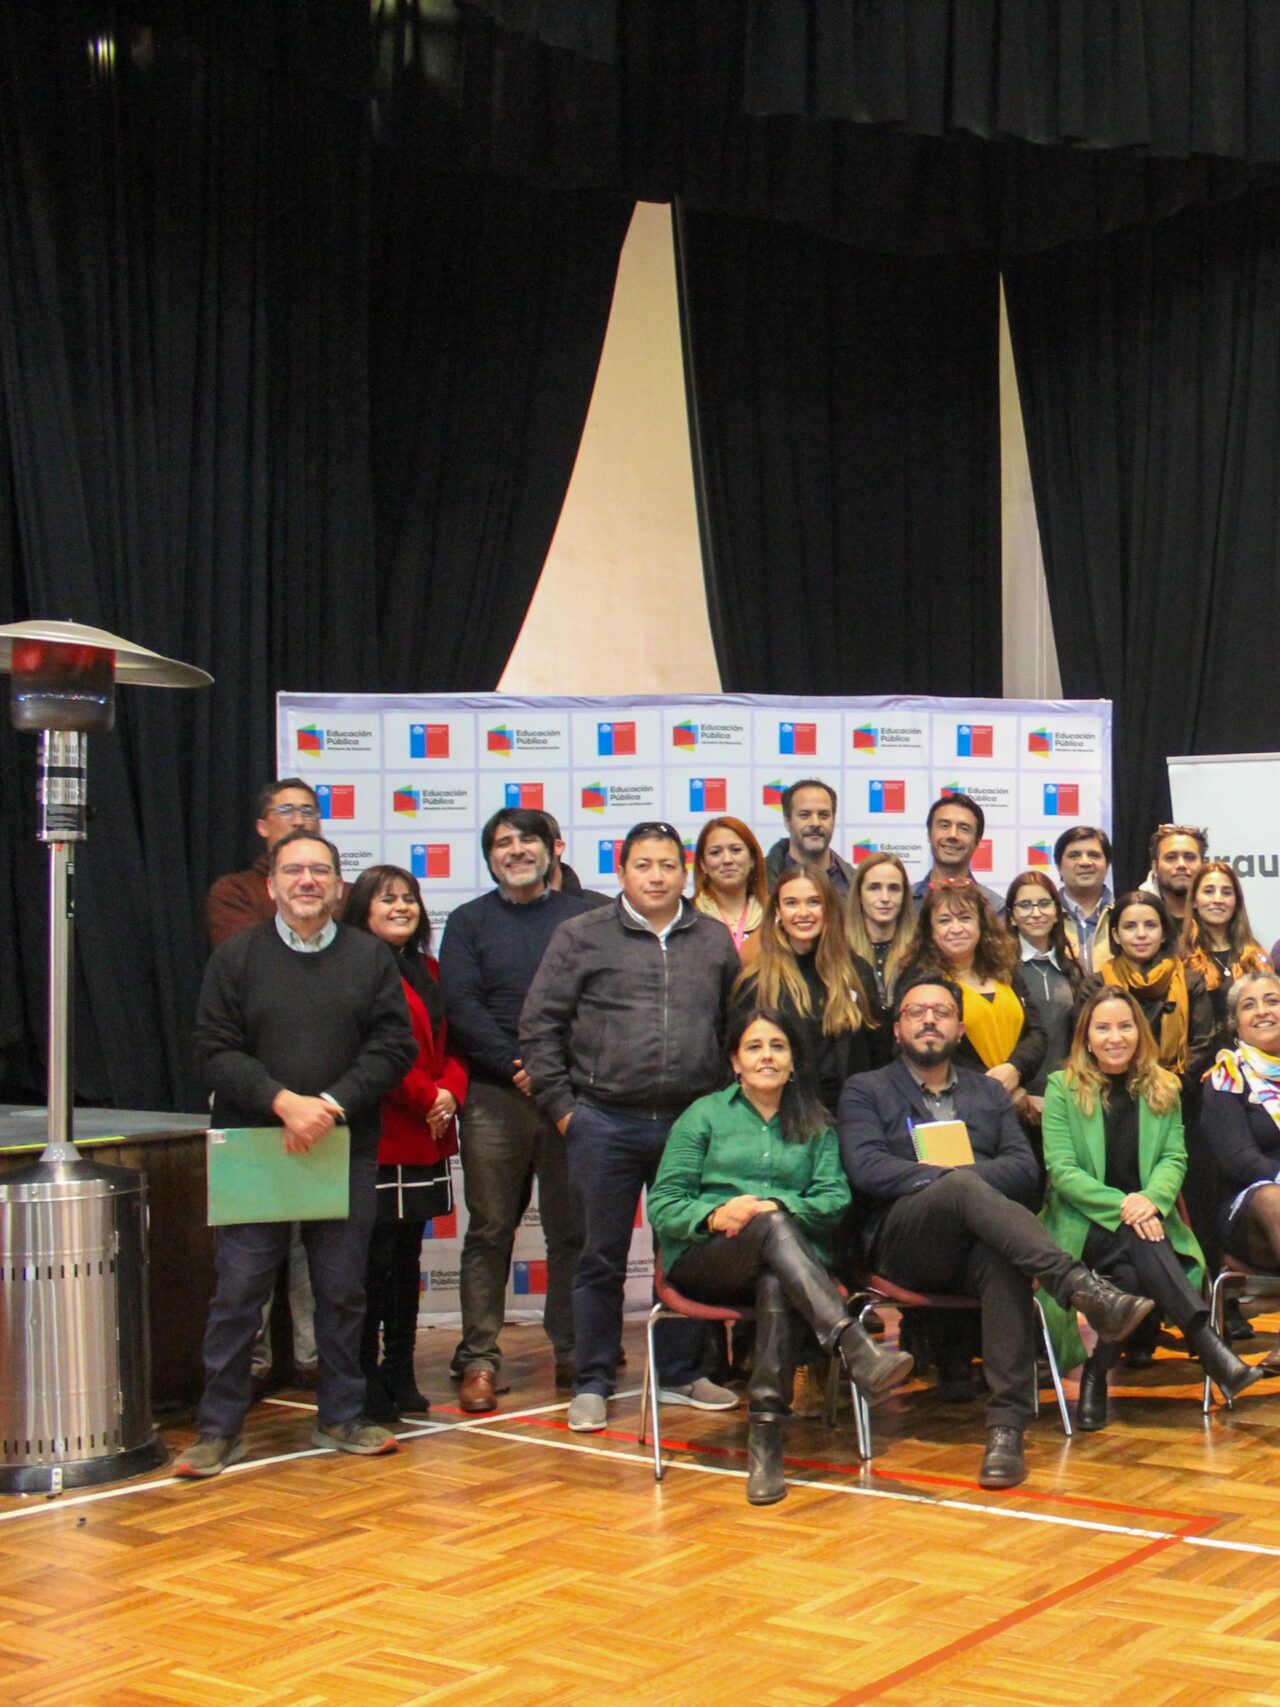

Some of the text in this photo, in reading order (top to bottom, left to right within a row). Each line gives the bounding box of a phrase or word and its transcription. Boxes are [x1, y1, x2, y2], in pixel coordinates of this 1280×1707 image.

[701, 724, 743, 732] Educación
[880, 727, 922, 735] Educación
[326, 729, 373, 737] Educación
[516, 729, 561, 737] Educación
[1055, 732, 1096, 740] Educación
[326, 737, 360, 745] Pública
[516, 737, 548, 745] Pública
[422, 789, 468, 797] Educación
[610, 785, 654, 793] Educación
[967, 786, 1009, 795] Educación
[422, 797, 455, 805] Pública
[610, 793, 641, 801] Pública
[880, 843, 922, 851] Educación
